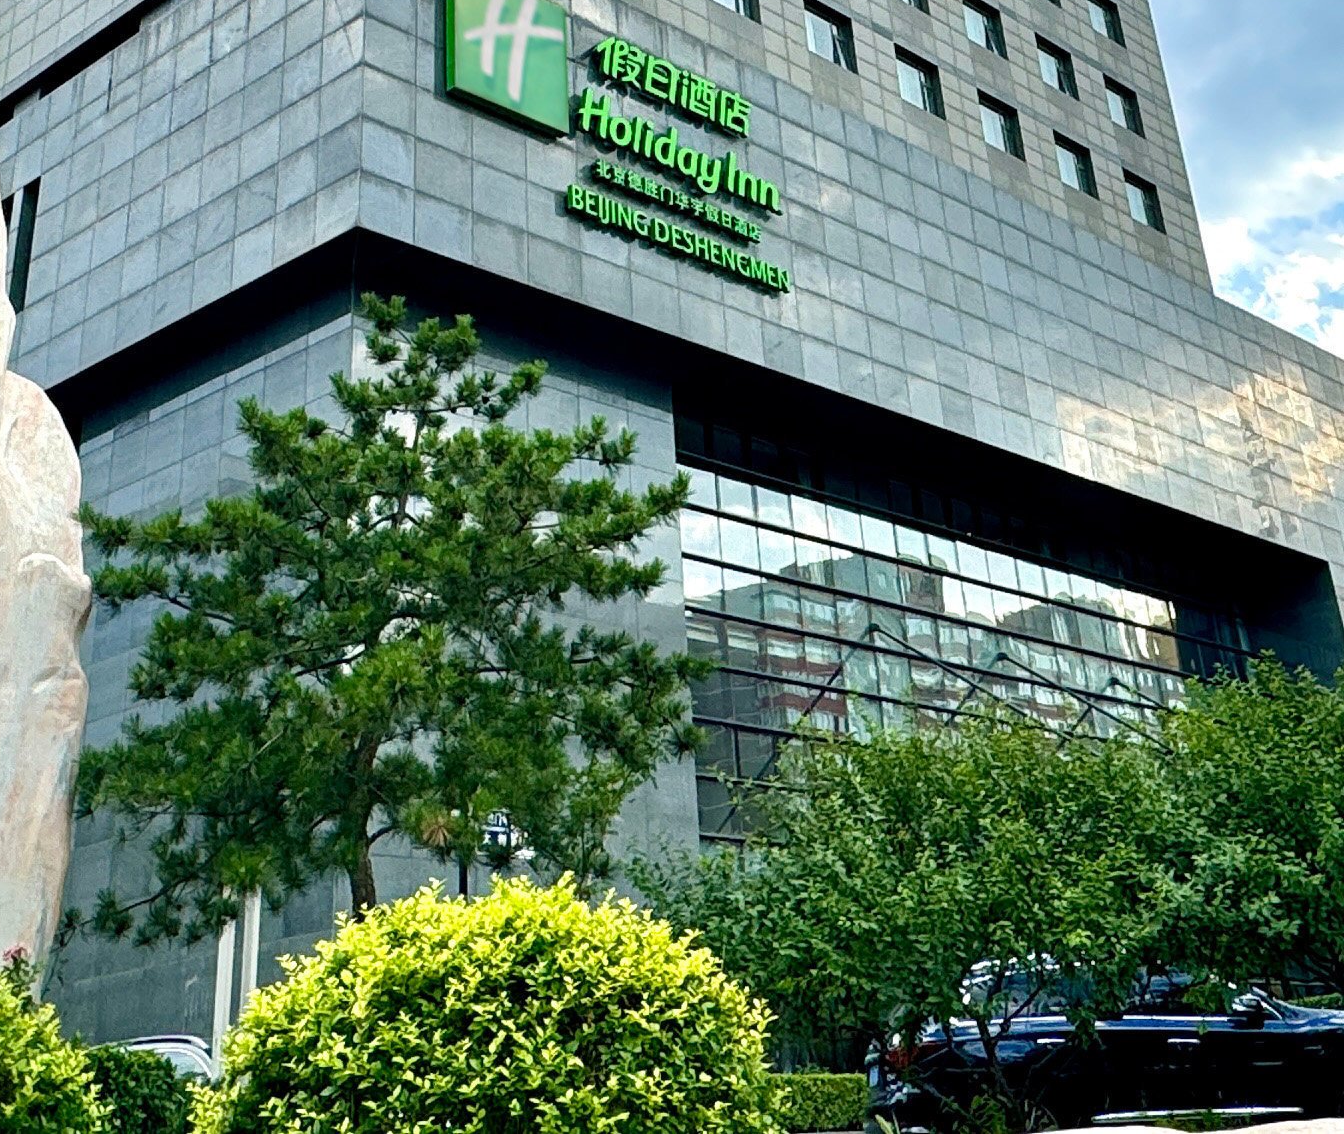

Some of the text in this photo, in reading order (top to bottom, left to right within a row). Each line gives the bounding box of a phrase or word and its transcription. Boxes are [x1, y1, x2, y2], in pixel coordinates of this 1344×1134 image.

[595, 36, 752, 136] 假日酒店
[578, 87, 782, 214] Holiday Inn
[569, 184, 791, 292] BEIJING DESHENGMEN
